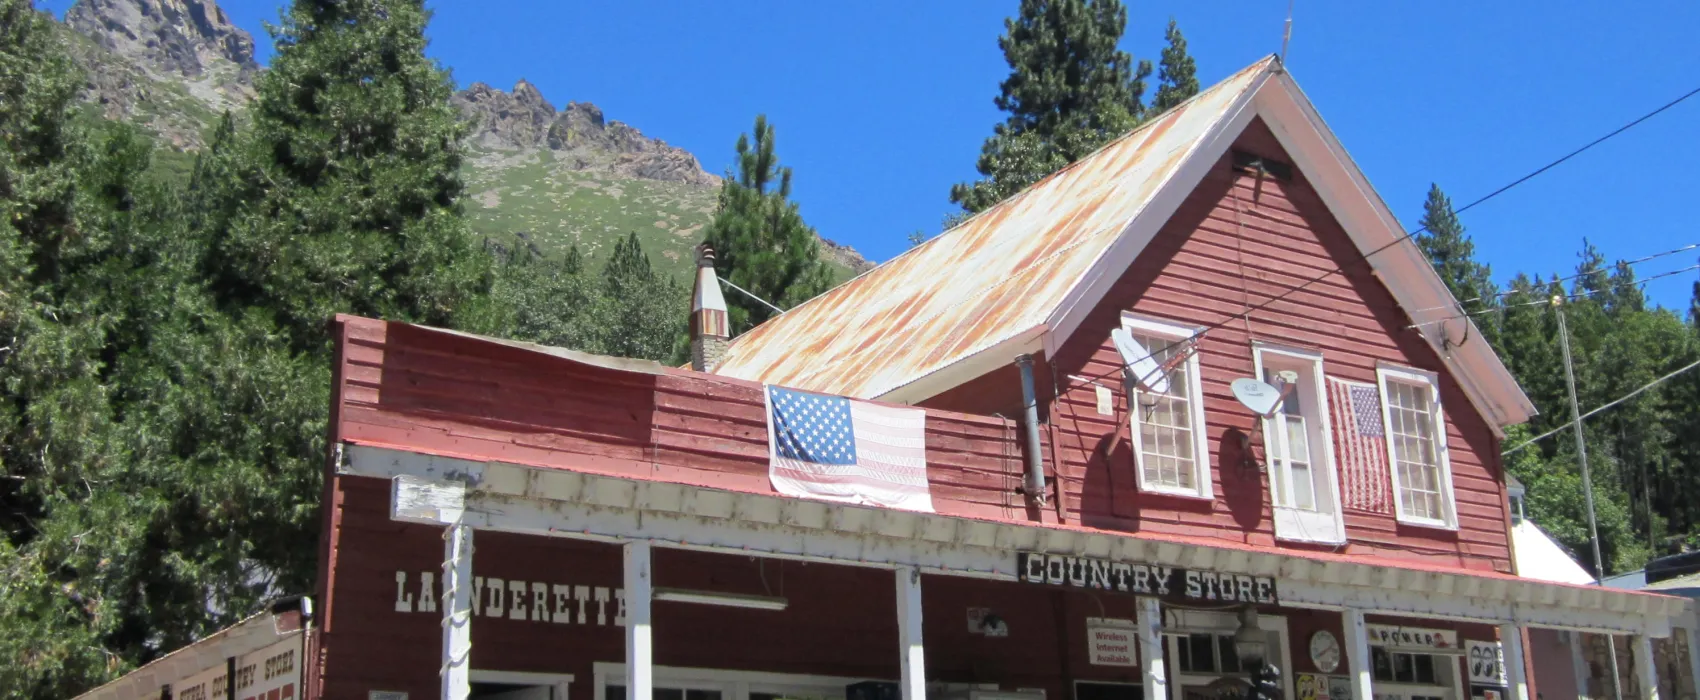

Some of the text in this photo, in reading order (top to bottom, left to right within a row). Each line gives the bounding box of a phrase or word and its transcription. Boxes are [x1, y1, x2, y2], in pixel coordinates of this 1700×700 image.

[1027, 553, 1275, 604] COUNTRY STORE
[395, 570, 626, 627] LANDERETTE
[1095, 632, 1128, 642] Wireless
[1380, 630, 1434, 645] POWER
[1096, 643, 1128, 653] Internet
[1097, 654, 1130, 664] Available
[212, 664, 256, 698] COUTRY
[265, 648, 294, 681] STORE
